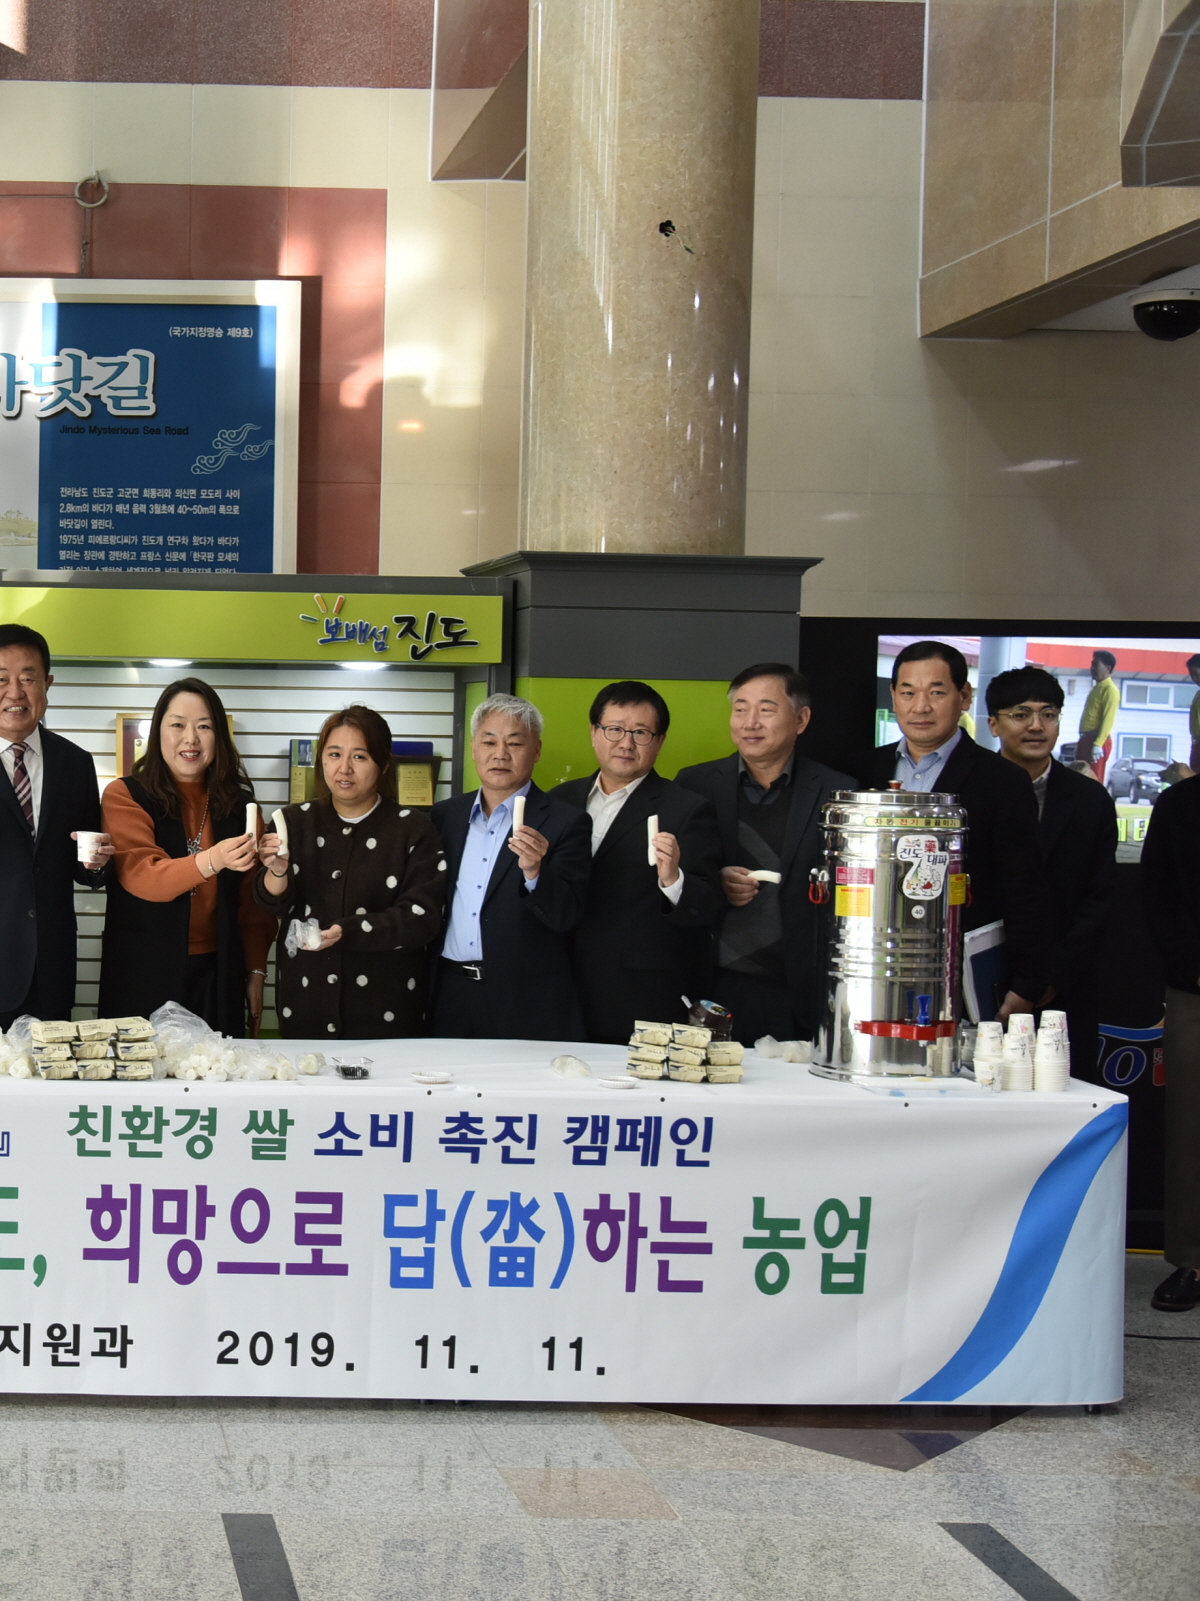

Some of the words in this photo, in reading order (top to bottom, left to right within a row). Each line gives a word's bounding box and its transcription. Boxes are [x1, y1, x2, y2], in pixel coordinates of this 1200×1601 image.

[169, 327, 224, 338] (국가지정명승
[227, 327, 254, 338] 제9호)
[60, 425, 86, 435] Jindo
[89, 425, 140, 437] Mysterious
[143, 426, 161, 435] Sea
[165, 426, 190, 436] Road
[60, 487, 88, 497] 전라남도
[92, 487, 114, 497] 진도군
[117, 487, 139, 497] 고군면
[143, 488, 171, 498] 회동리와
[175, 488, 197, 498] 의신면
[200, 488, 222, 498] 모도리
[226, 489, 241, 499] 사이
[60, 503, 89, 513] 2.8km의
[92, 503, 113, 513] 바다가
[116, 503, 130, 513] 매년
[132, 503, 146, 513] 음력
[149, 503, 175, 513] 3월초에
[219, 504, 240, 514] 폭으로
[59, 519, 88, 529] 바닷길이
[91, 519, 115, 529] 열린다.
[59, 535, 84, 545] 1975년
[142, 535, 163, 545] 진도개
[167, 536, 189, 546] 연구차
[192, 536, 214, 546] 왔다가
[218, 536, 239, 546] 바다가
[59, 551, 80, 560] 열리는
[84, 551, 105, 560] 장관에
[109, 551, 137, 560] 경탄하고
[140, 552, 162, 561] 프랑스
[165, 552, 186, 561] 신문에
[217, 552, 239, 561] 모세의
[318, 618, 390, 653] 보배섬
[393, 611, 479, 661] 진도
[900, 818, 919, 826] 전기
[900, 847, 923, 859] 진도
[927, 854, 948, 866] 대파
[66, 1104, 219, 1161] 친환경
[242, 1108, 295, 1161] 쌀
[313, 1110, 414, 1164] 소비
[438, 1110, 538, 1166] 촉진
[562, 1114, 714, 1168] 캠페인
[82, 1183, 349, 1286] 희망으로
[383, 1188, 714, 1294] 답(畓)하는
[742, 1196, 873, 1296] 농업
[216, 1329, 356, 1372] 2019.
[414, 1334, 480, 1374] 11.
[541, 1335, 607, 1376] 11.
